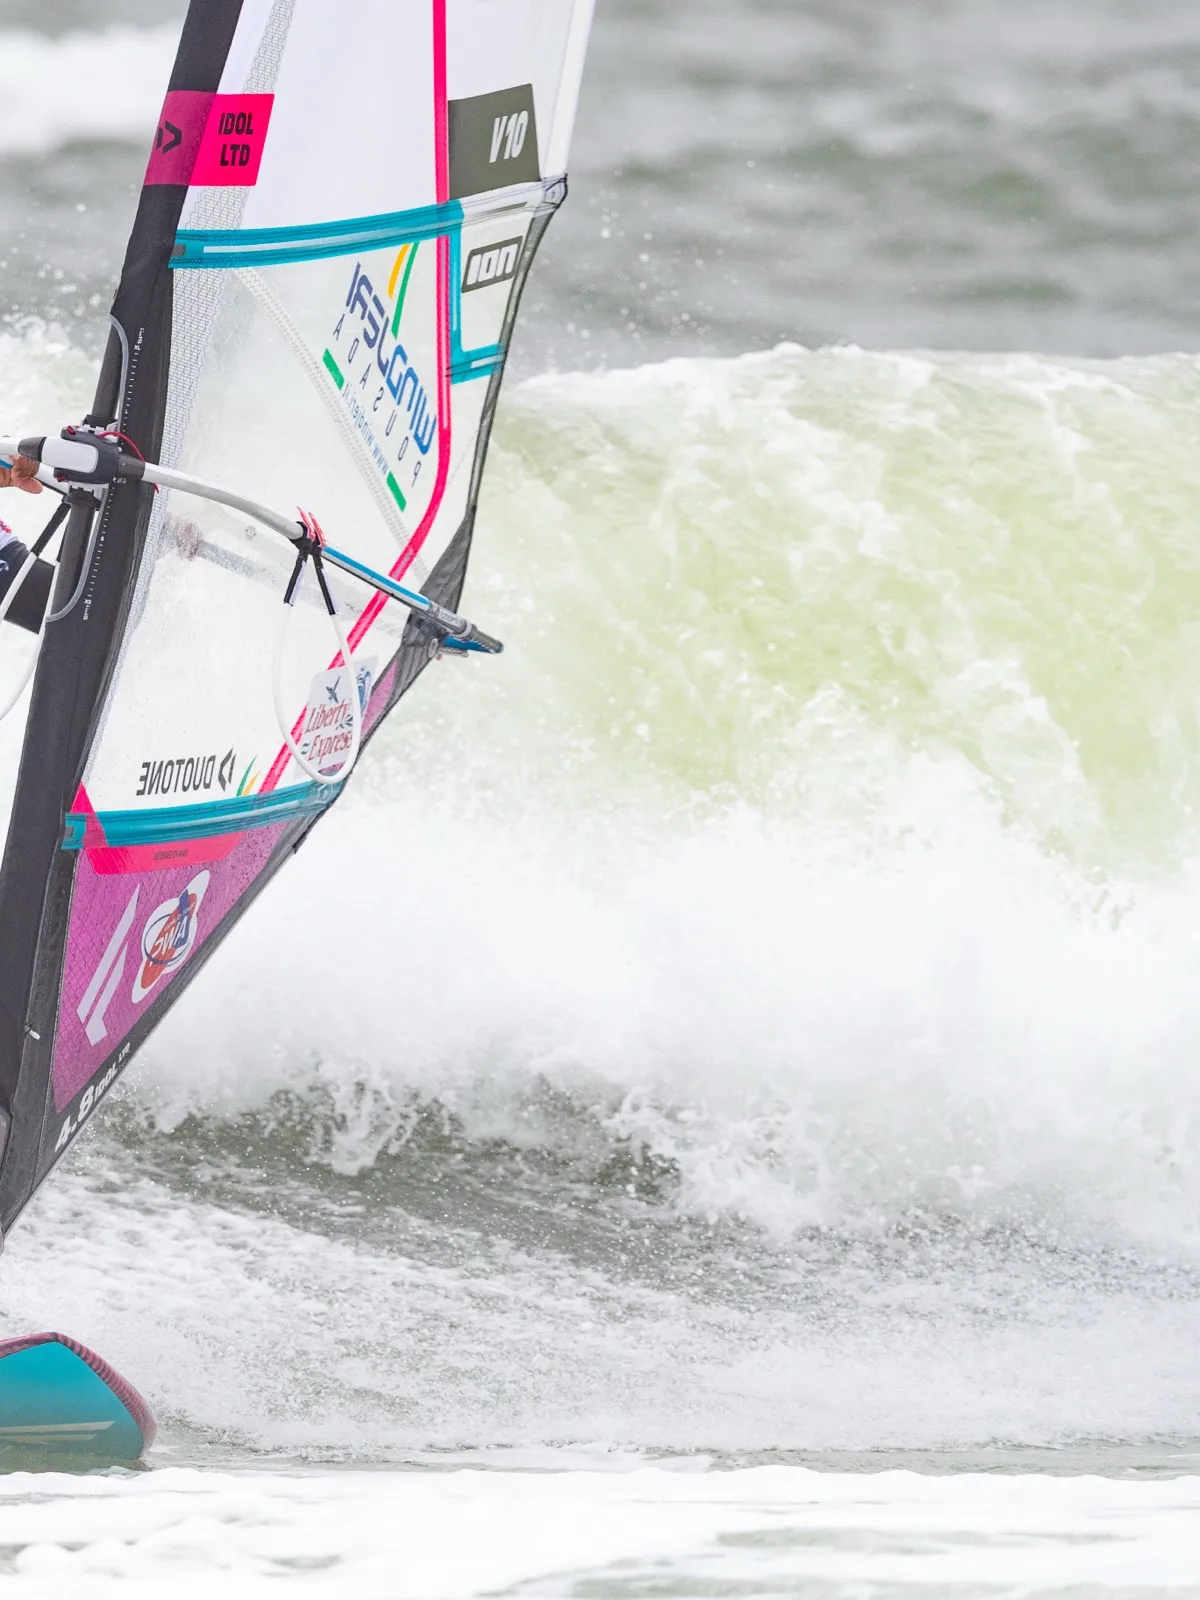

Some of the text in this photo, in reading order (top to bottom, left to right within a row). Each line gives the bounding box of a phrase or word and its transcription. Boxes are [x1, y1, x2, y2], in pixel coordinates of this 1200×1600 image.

[217, 111, 254, 135] IDOL
[489, 110, 529, 163] V10
[219, 143, 251, 167] LTD
[305, 699, 352, 734] Liberty
[307, 730, 353, 765] Express
[54, 1085, 95, 1153] 4.8
[94, 1061, 119, 1103] IDOL
